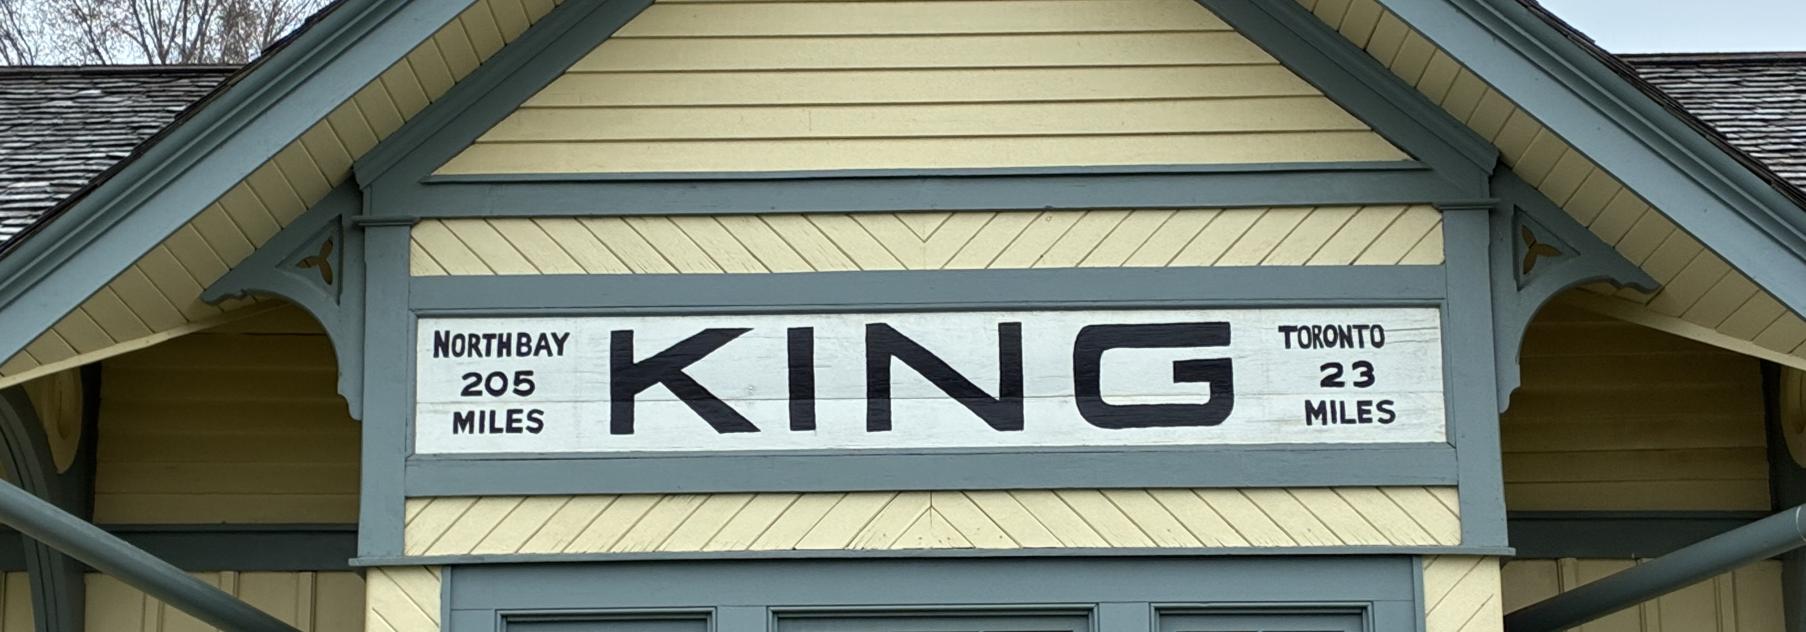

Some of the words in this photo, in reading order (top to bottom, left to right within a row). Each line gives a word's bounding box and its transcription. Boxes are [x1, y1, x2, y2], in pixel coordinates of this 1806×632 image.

[1278, 324, 1386, 350] TORONTO
[460, 370, 536, 397] 205
[609, 321, 1235, 435] KING
[1319, 360, 1376, 389] 23
[452, 408, 544, 435] MILES
[1304, 399, 1396, 426] MILES
